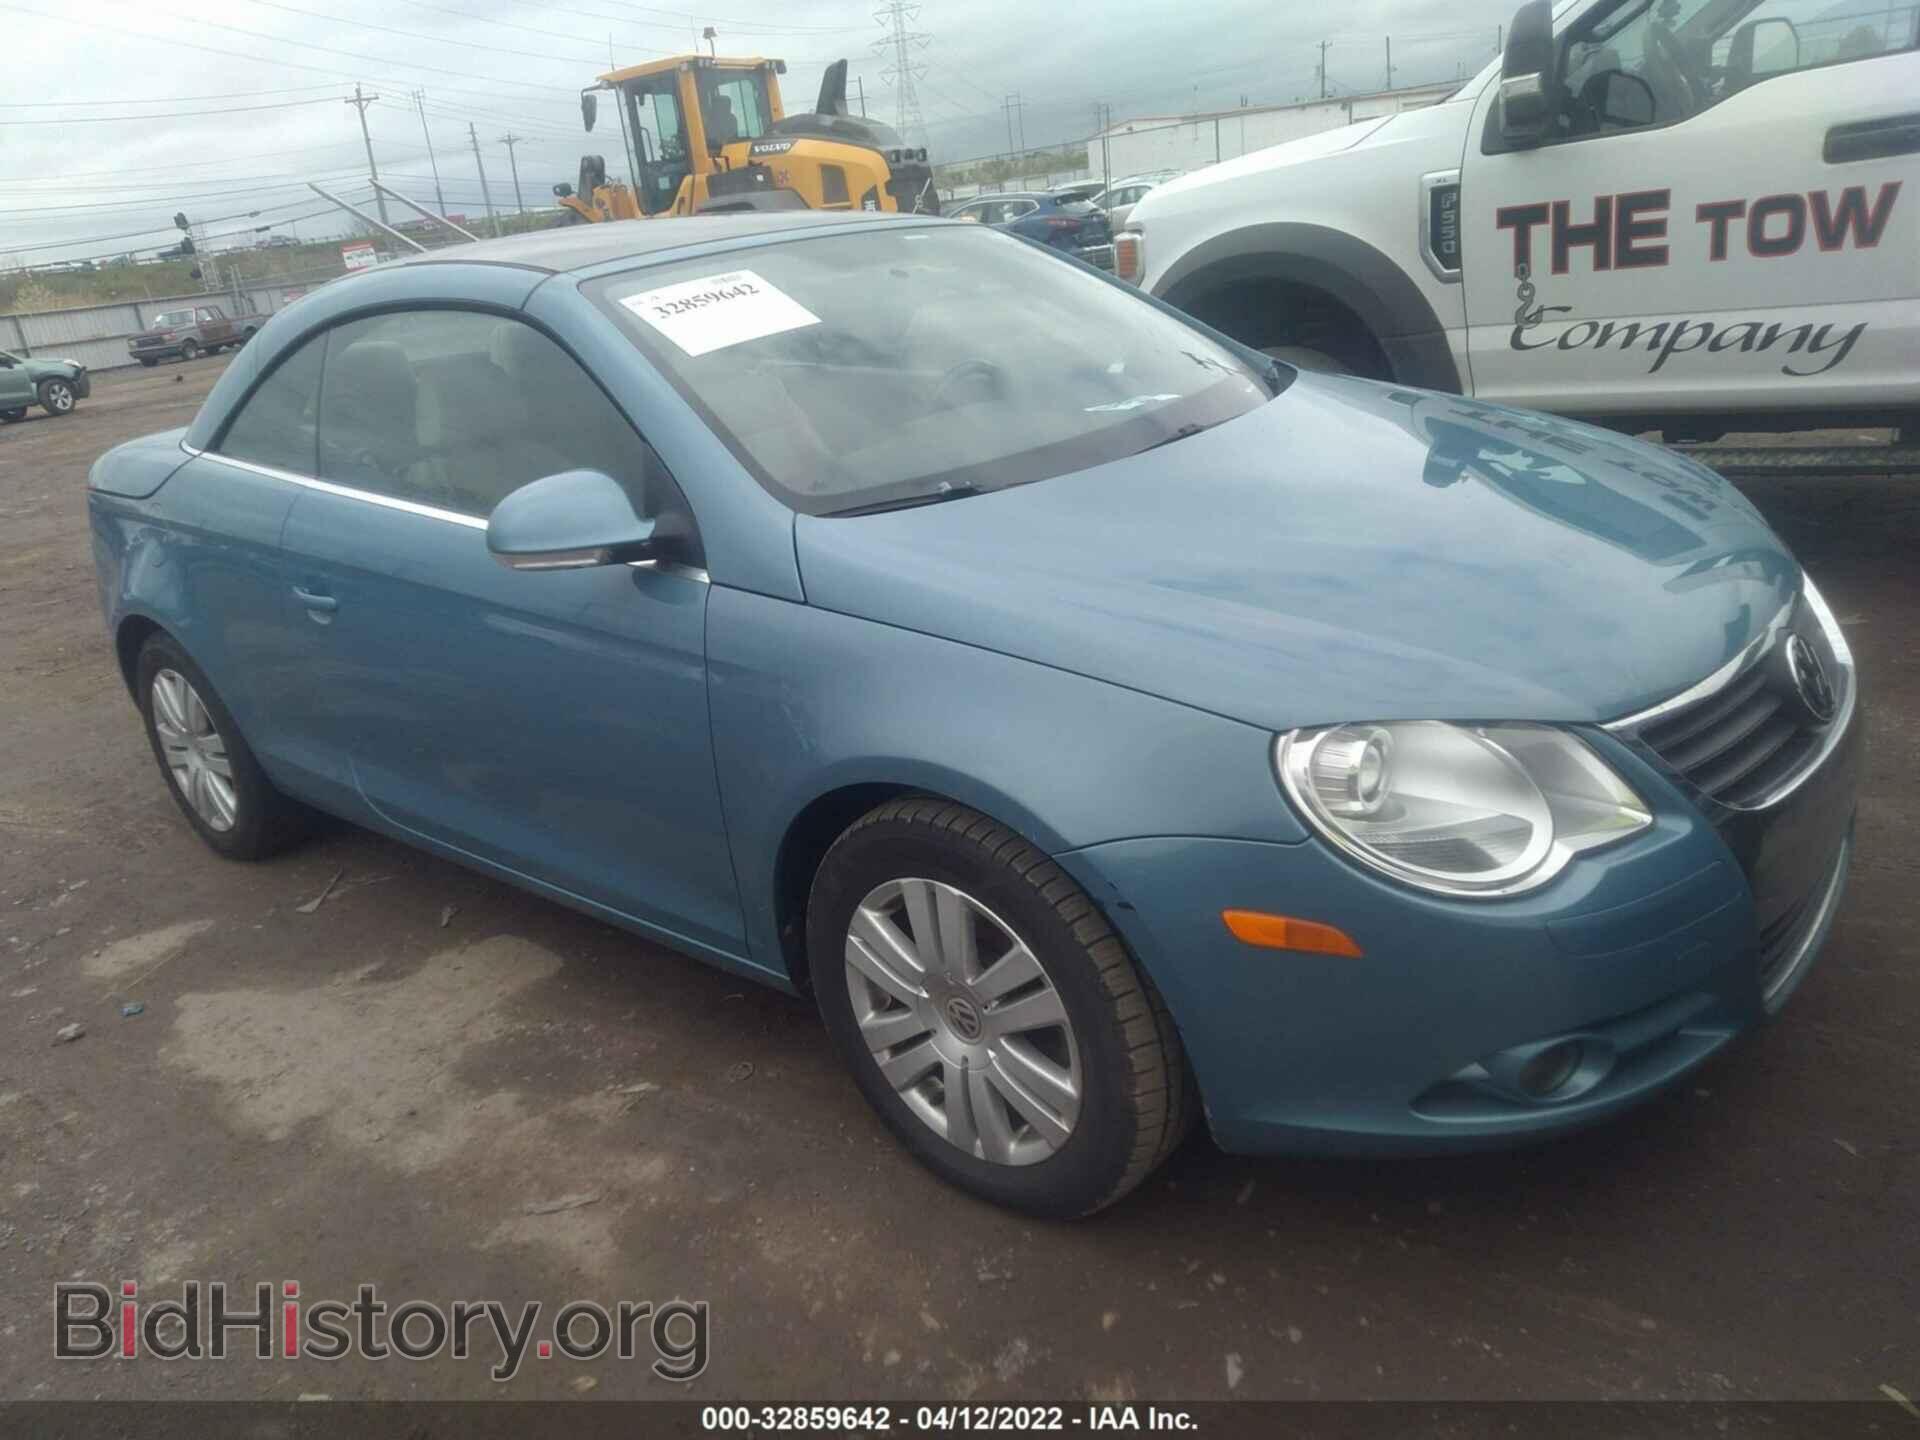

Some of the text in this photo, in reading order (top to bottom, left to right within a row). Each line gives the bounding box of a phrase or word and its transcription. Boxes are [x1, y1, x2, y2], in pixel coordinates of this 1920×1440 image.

[754, 143, 792, 153] VOLVO
[1497, 180, 1904, 278] THE TOW
[653, 283, 760, 320] 32859642
[1509, 305, 1869, 377] Company
